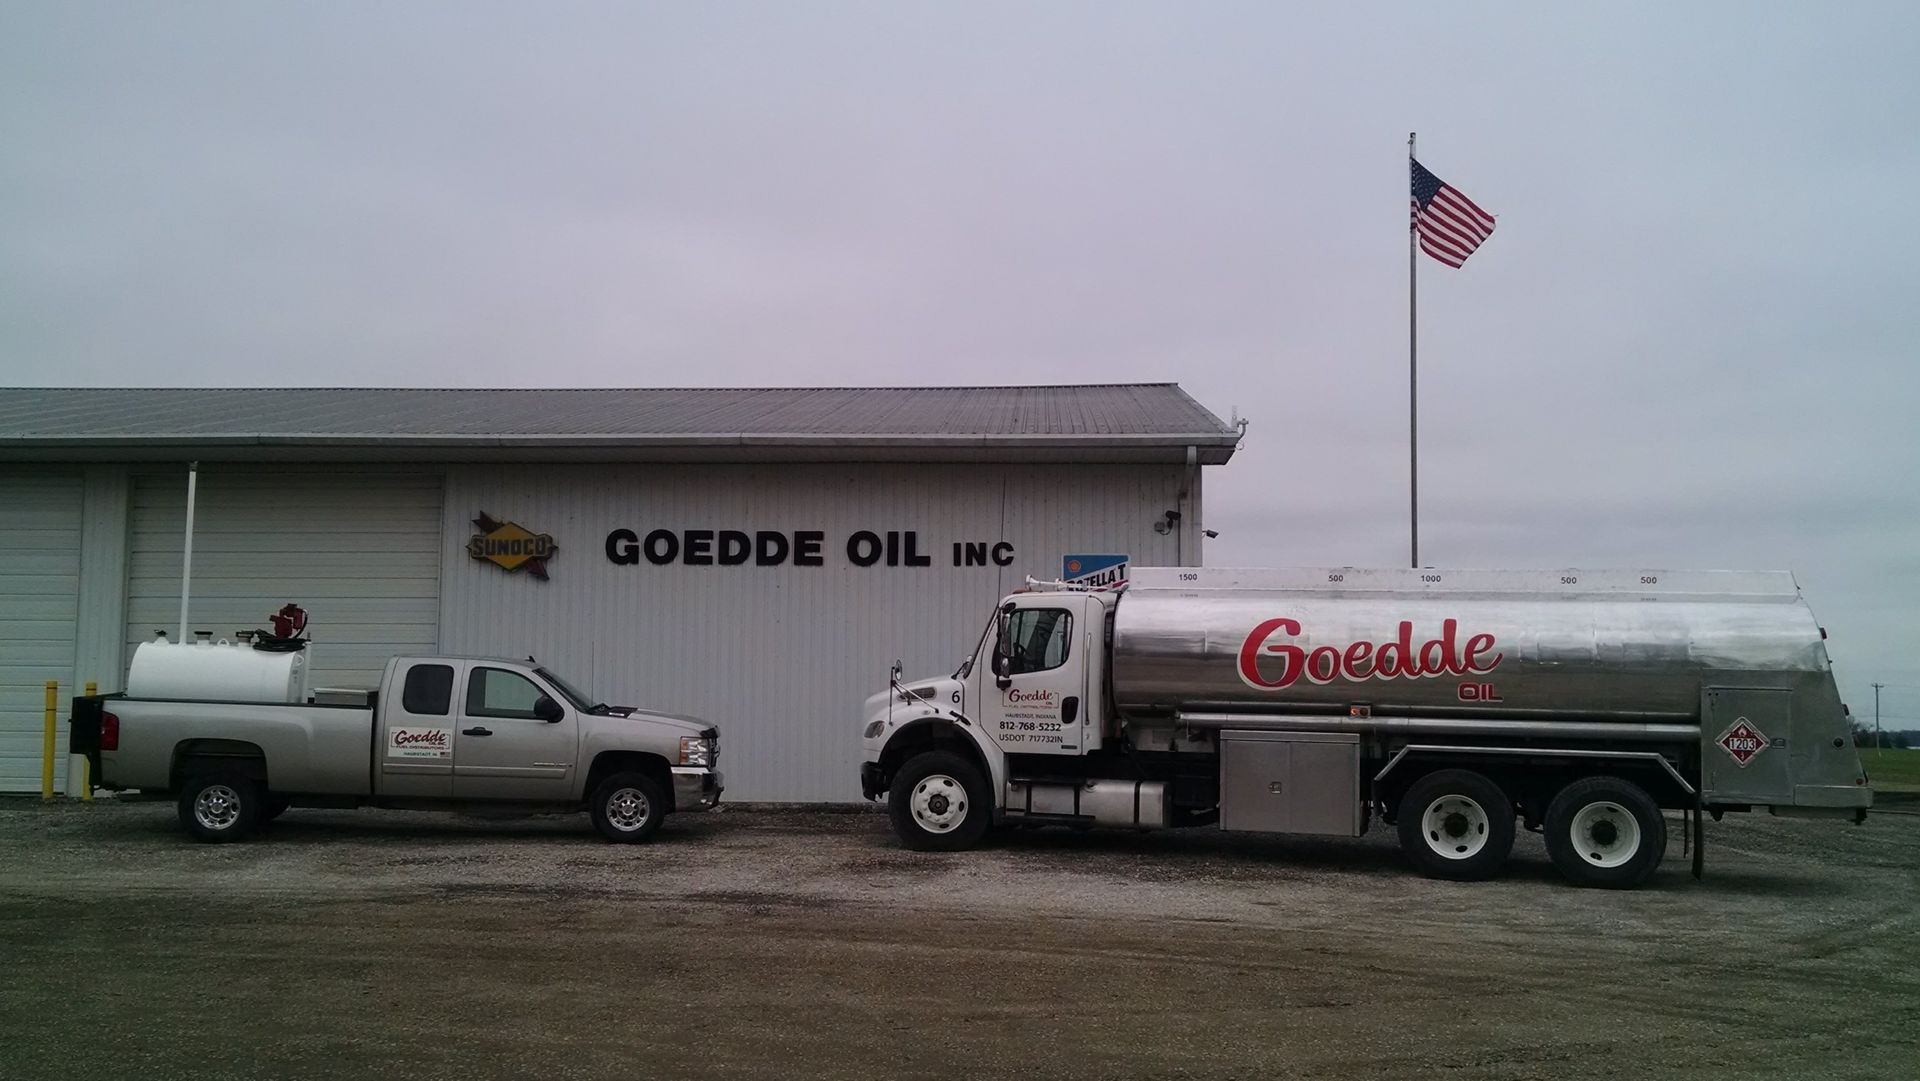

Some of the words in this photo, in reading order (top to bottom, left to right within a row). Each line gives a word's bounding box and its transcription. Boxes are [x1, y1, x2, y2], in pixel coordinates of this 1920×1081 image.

[471, 535, 553, 558] SUNOCO
[605, 529, 824, 566] GOEDDE
[846, 530, 931, 567] OIL
[953, 541, 1015, 567] INC
[1179, 573, 1198, 581] 1500
[1328, 574, 1344, 582] 500
[1421, 574, 1441, 582] 1000
[1561, 576, 1577, 584] 500
[1640, 576, 1657, 584] 500
[1237, 617, 1503, 691] Goedde
[951, 690, 960, 704] 6
[1008, 688, 1054, 703] Goedde
[1457, 682, 1503, 702] OIL
[999, 721, 1062, 732] 812-768-5232
[395, 730, 446, 745] Goedde
[999, 734, 1025, 742] USDOT
[1730, 738, 1756, 750] 1203
